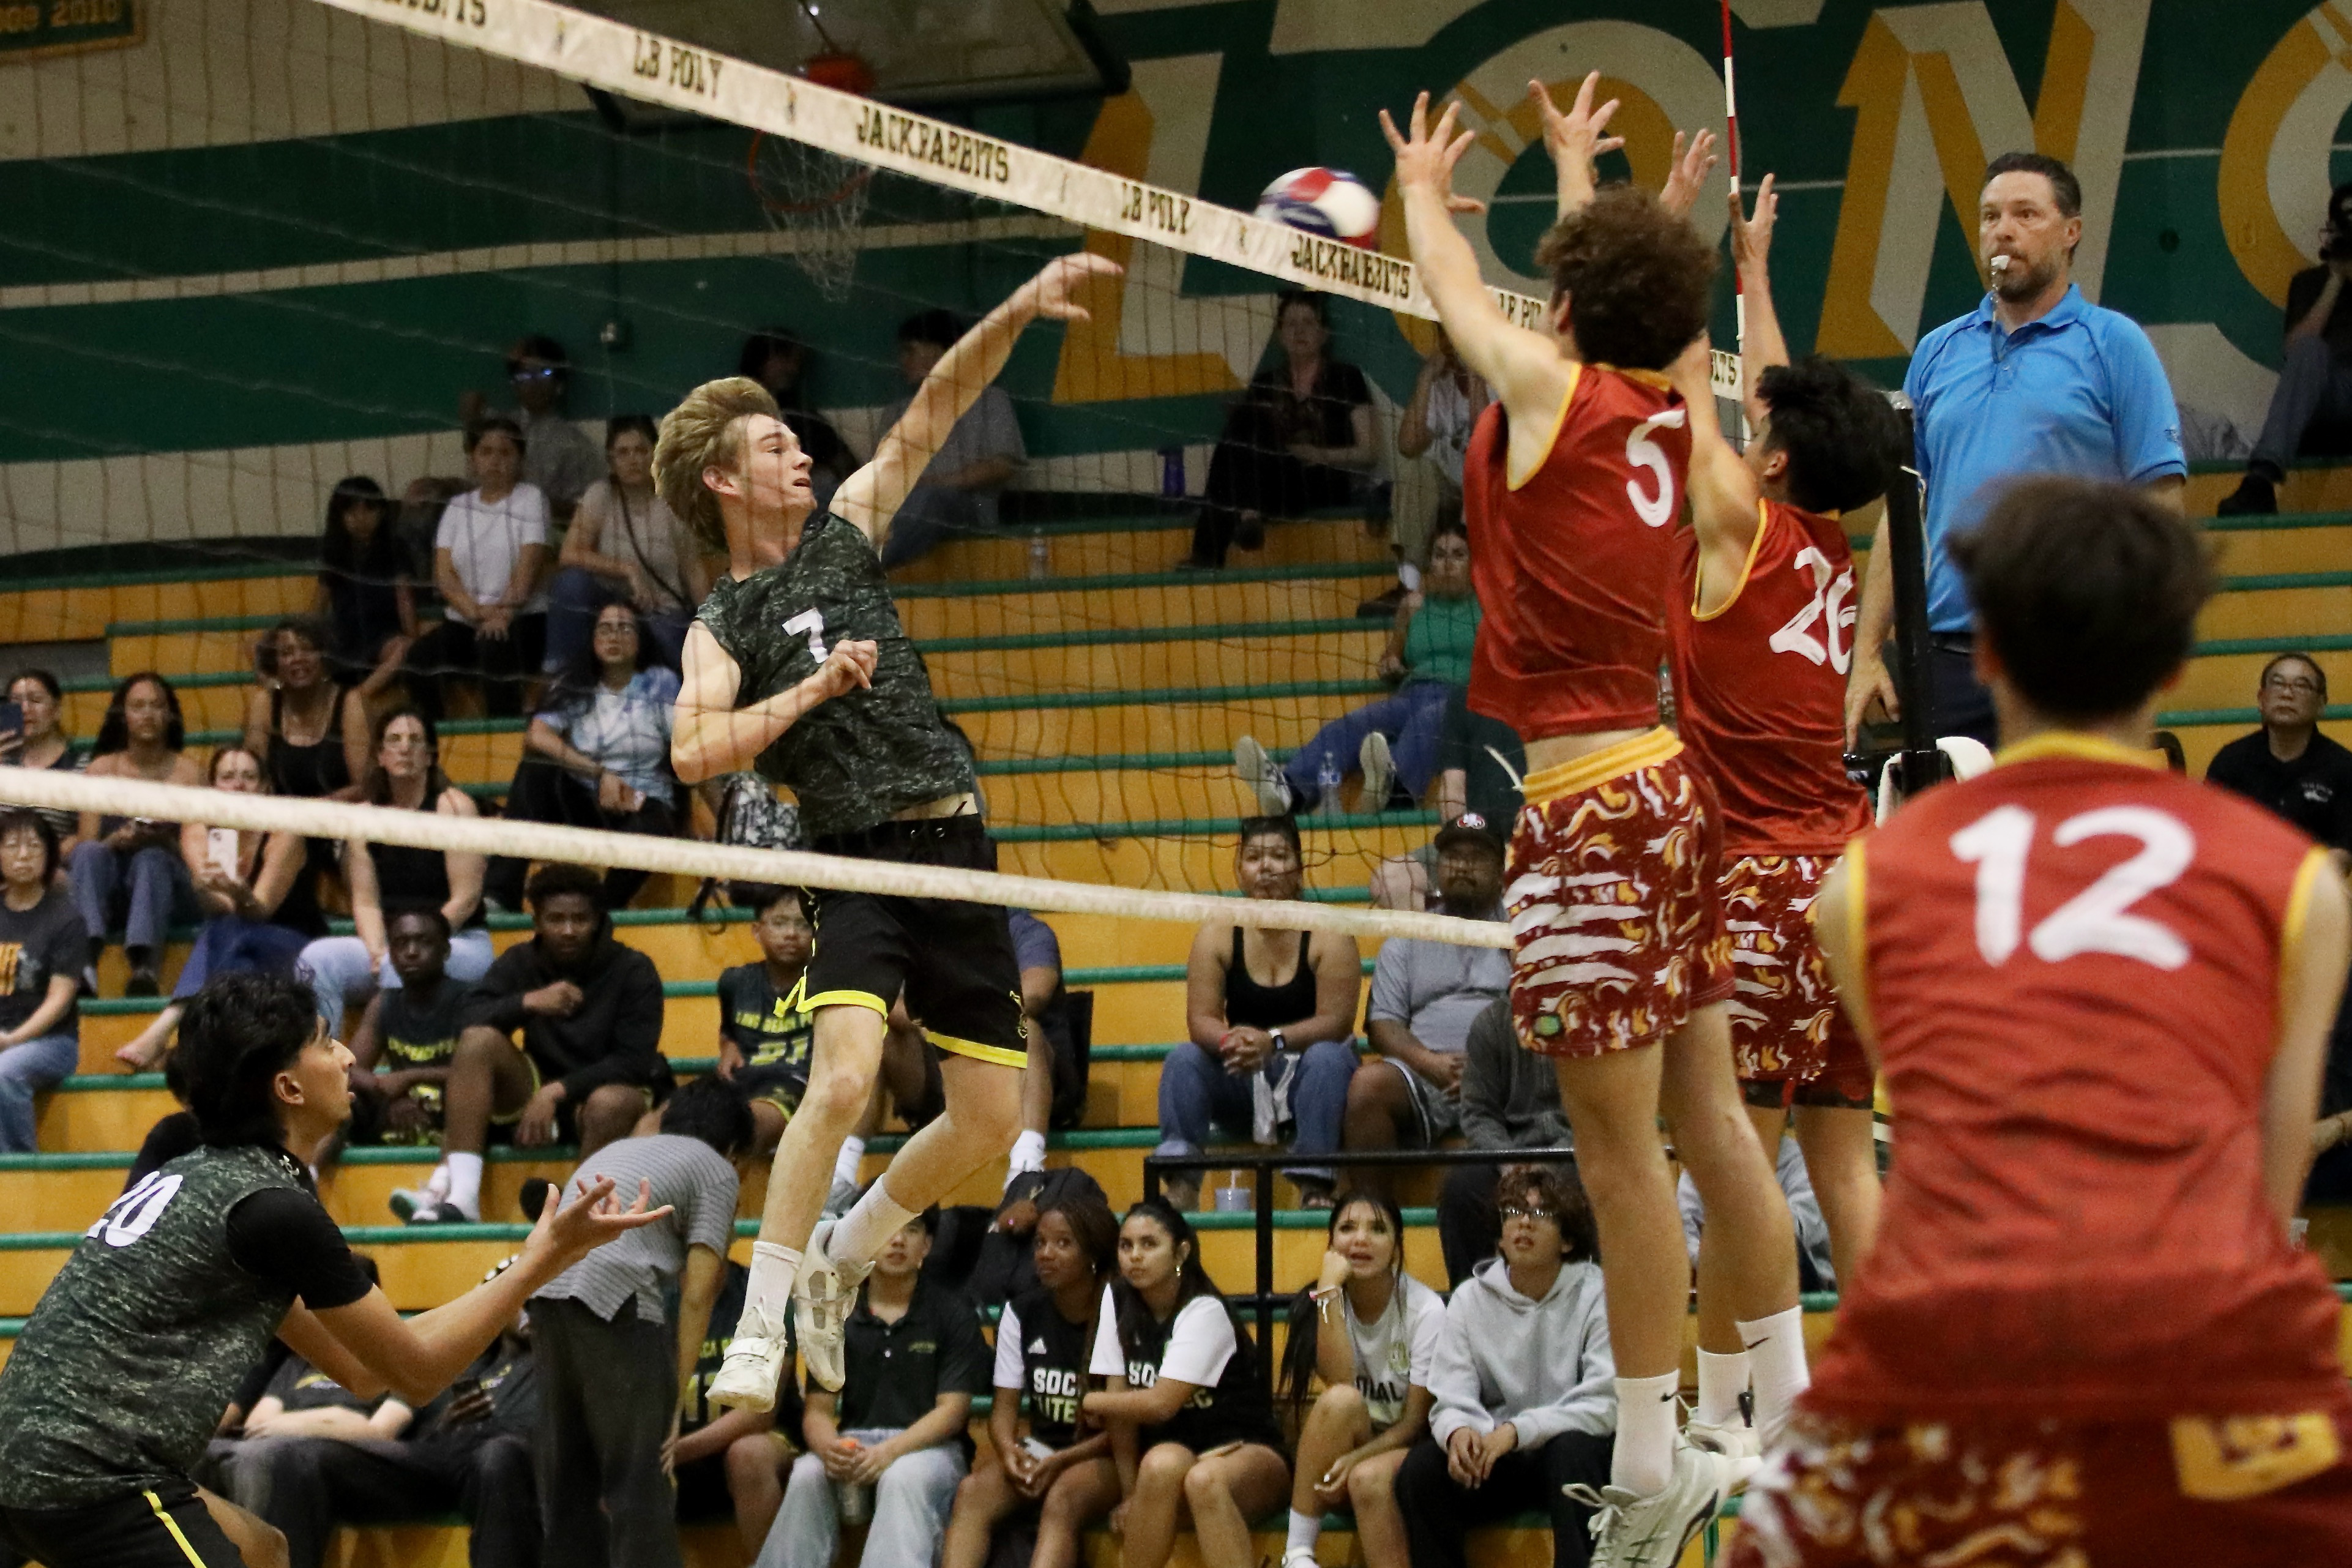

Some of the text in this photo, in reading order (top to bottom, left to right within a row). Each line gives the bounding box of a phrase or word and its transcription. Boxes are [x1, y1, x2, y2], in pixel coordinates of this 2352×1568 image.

[633, 35, 723, 100] LB POLY
[1291, 234, 1411, 299] JACKRABBITS
[1626, 409, 1686, 528] 5
[782, 607, 829, 664] 7
[1769, 546, 1857, 675] 26
[1949, 803, 2196, 971] 12
[1033, 1367, 1078, 1398] SOC
